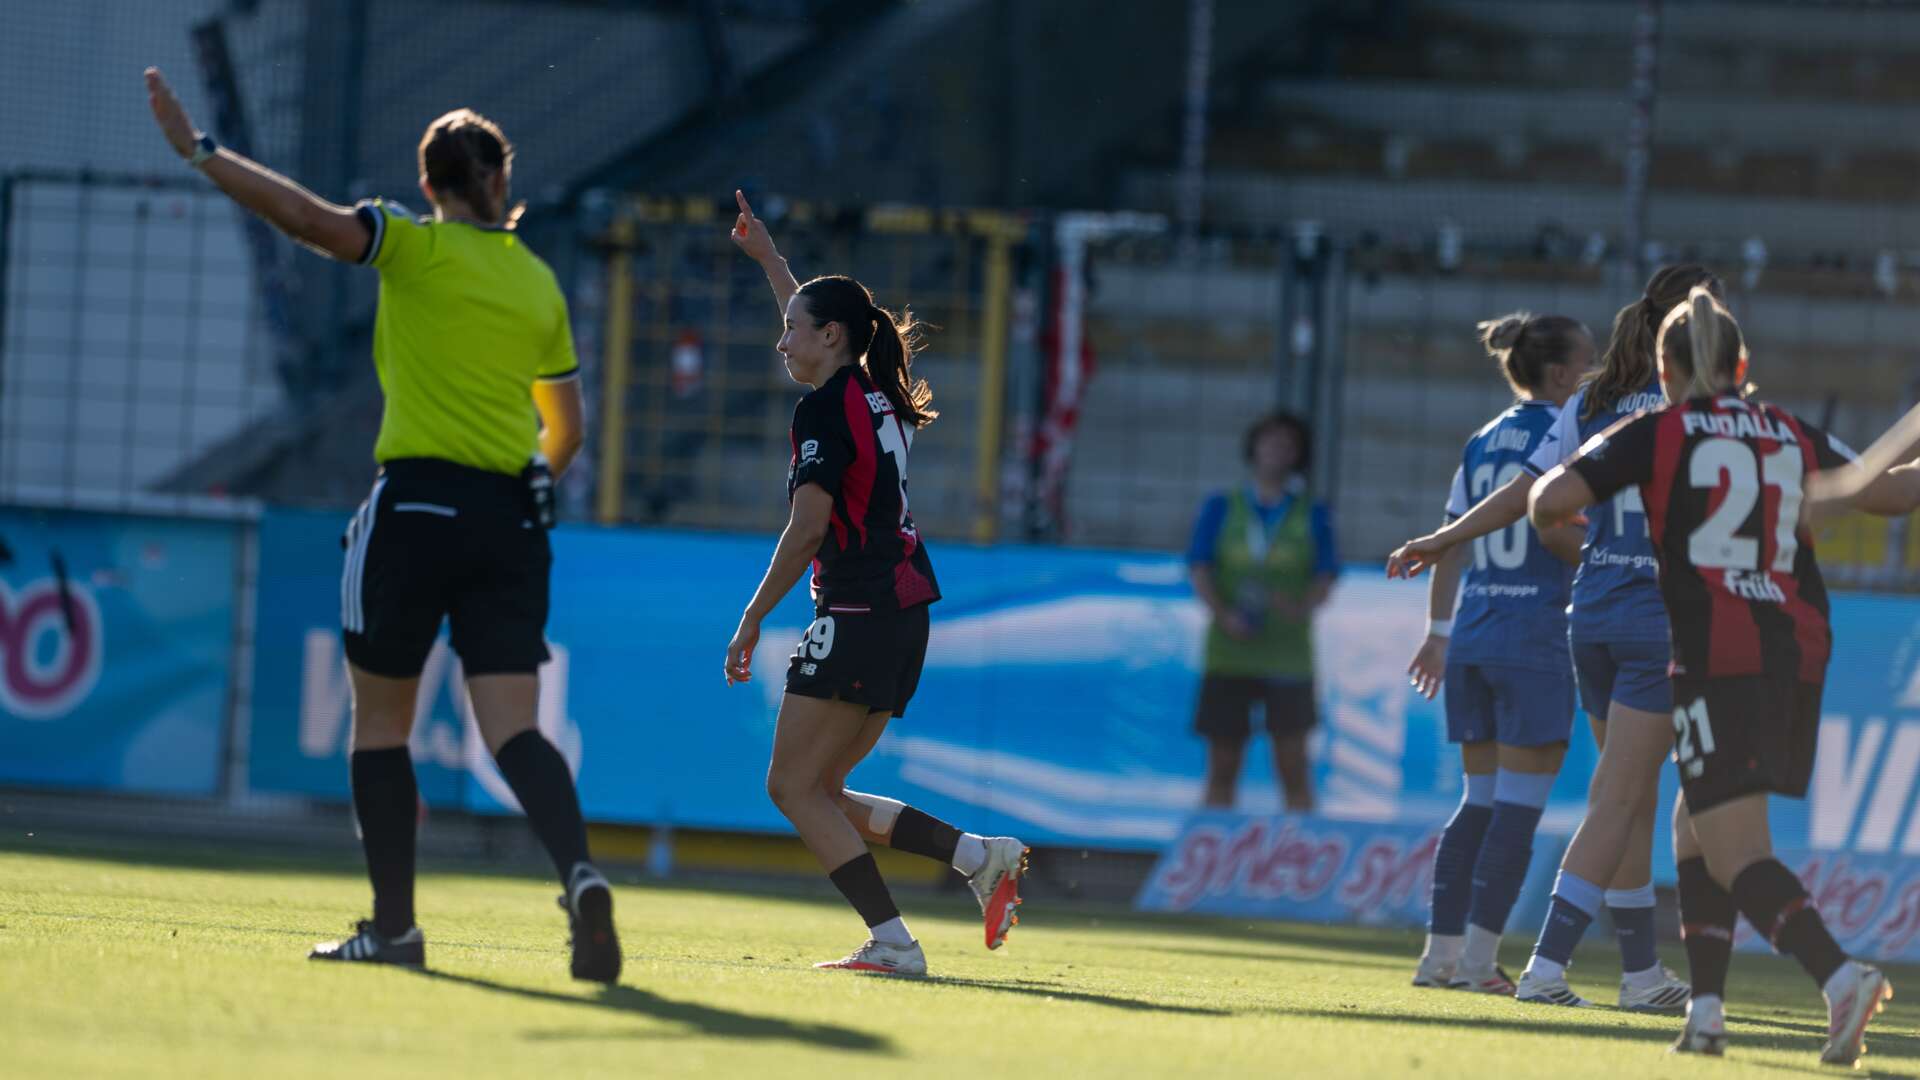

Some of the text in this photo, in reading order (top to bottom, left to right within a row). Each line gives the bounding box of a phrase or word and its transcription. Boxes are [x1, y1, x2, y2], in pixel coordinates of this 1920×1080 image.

[865, 391, 896, 414] BE
[1682, 412, 1797, 443] FUDALLA
[876, 414, 916, 526] 1
[1688, 437, 1804, 573] 21
[1672, 696, 1716, 762] 21
[1809, 715, 1920, 854] VI
